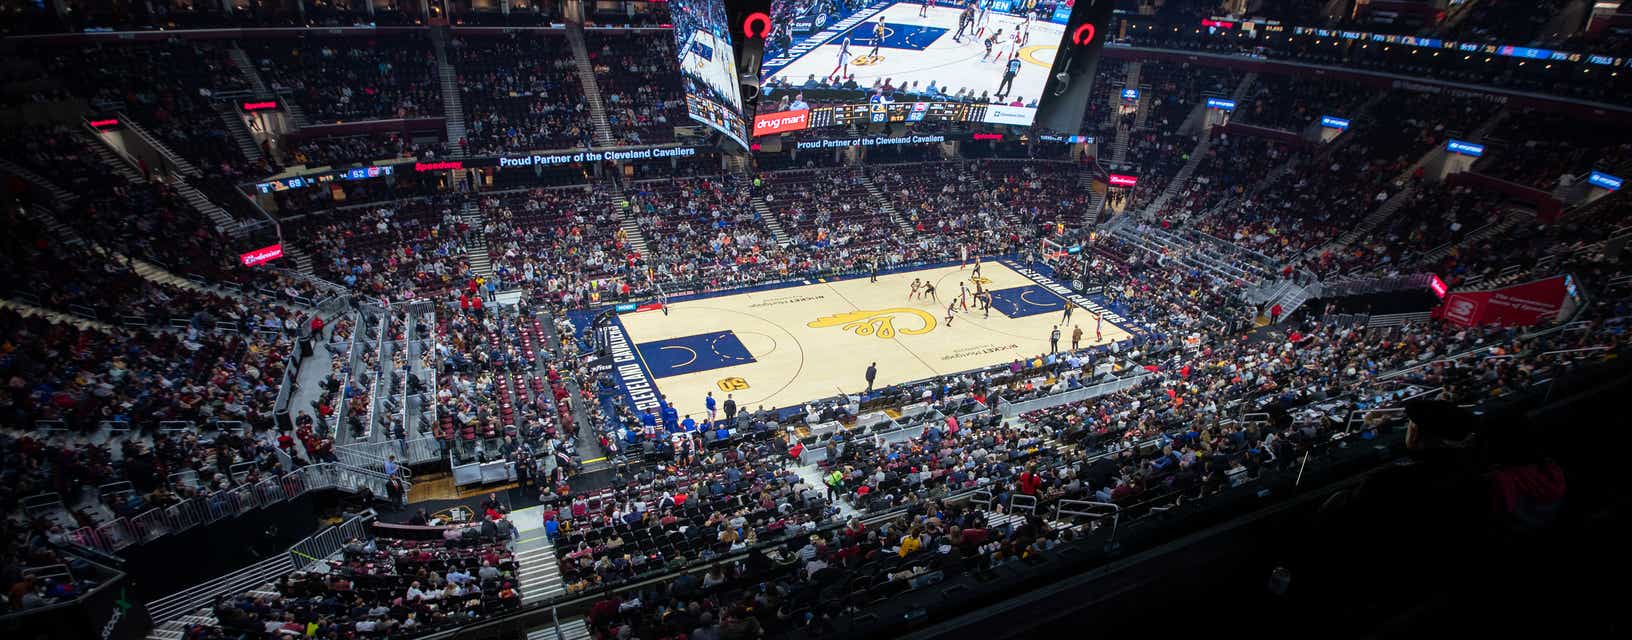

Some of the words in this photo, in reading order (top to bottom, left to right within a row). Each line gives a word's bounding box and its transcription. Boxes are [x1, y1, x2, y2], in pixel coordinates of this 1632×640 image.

[757, 117, 781, 129] drug
[781, 113, 805, 125] mart
[873, 113, 885, 122] 69
[797, 141, 821, 149] Proud
[822, 138, 851, 148] Partner
[852, 138, 861, 146] of
[862, 137, 874, 145] the
[875, 136, 911, 145] Cleveland
[912, 135, 944, 144] Cavaliers
[500, 156, 531, 167] Proud
[534, 154, 571, 166] Partner
[573, 152, 584, 163] of
[586, 152, 602, 162] the
[604, 148, 651, 160] Cleveland
[653, 146, 695, 157] Cavaliers
[289, 179, 301, 188] 69
[608, 325, 636, 363] CAVALIERS
[617, 362, 661, 411] CLEVELAND
